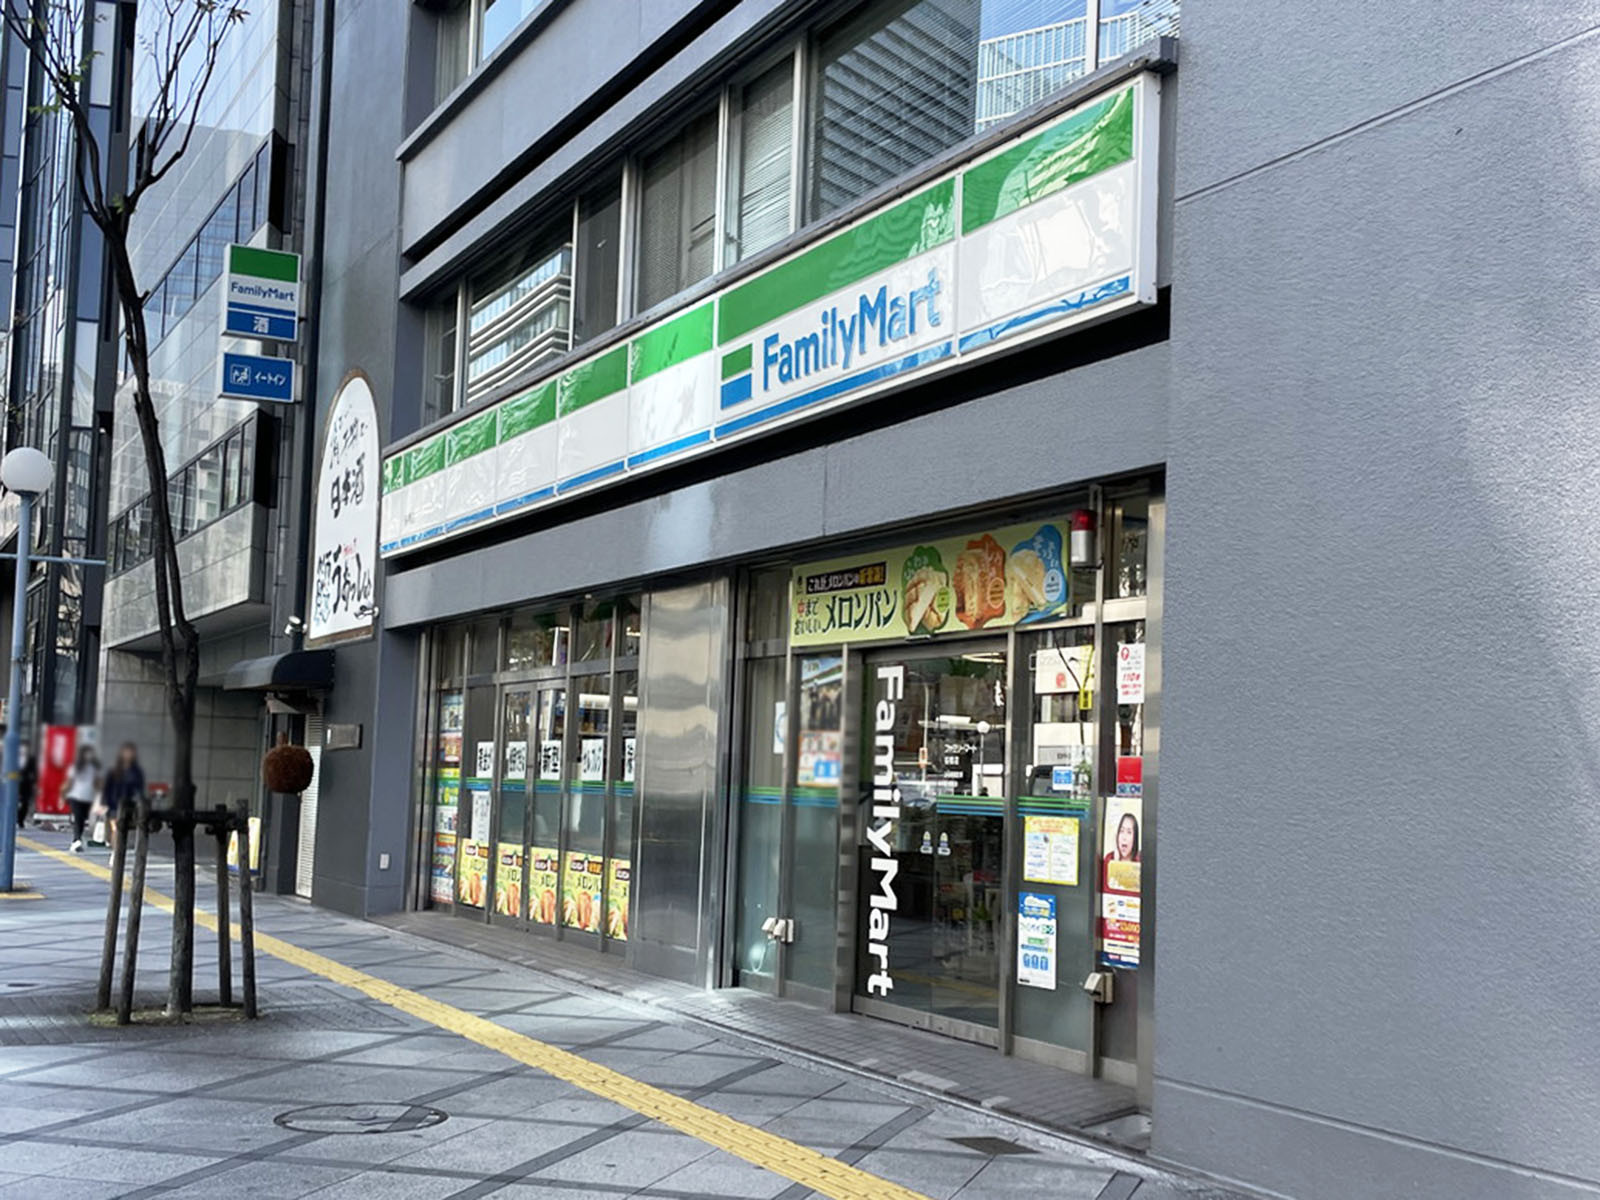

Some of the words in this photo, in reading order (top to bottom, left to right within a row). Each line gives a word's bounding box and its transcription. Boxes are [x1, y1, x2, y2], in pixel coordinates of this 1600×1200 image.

[231, 281, 294, 301] FamilyMart
[252, 315, 270, 334] 酒
[763, 266, 942, 392] FamilyMart
[255, 371, 287, 386] イートイン
[822, 588, 898, 634] メロンパン
[866, 665, 904, 997] FamilyMart
